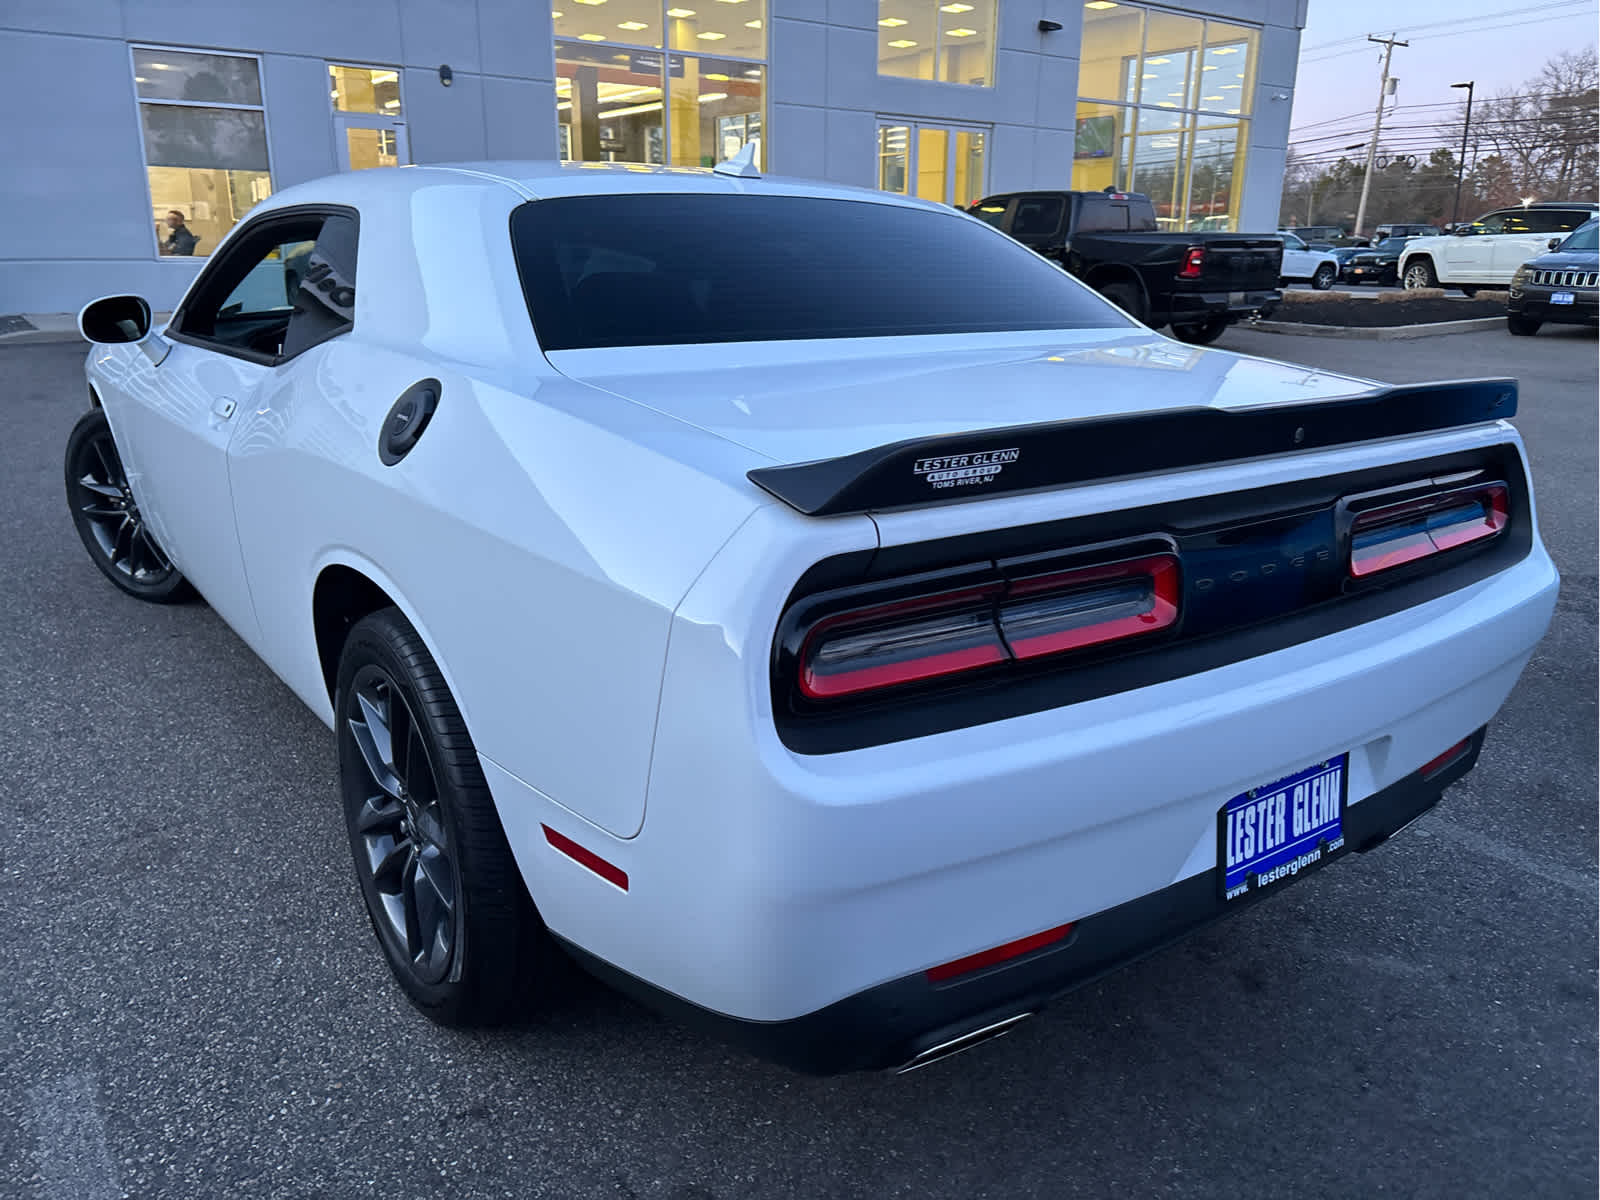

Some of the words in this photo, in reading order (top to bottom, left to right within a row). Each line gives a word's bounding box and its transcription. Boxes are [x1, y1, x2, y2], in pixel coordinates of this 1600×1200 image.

[914, 457, 969, 472] LESTER
[973, 450, 1020, 465] GLENN
[929, 472, 959, 481] AUTO
[932, 480, 955, 489] TOMS
[984, 475, 995, 483] NJ
[1195, 550, 1329, 590] DODGE
[1226, 792, 1287, 868] LESTER
[1292, 769, 1341, 838] GLENN
[1226, 884, 1249, 901] www.
[1258, 850, 1321, 887] lesterglenn
[1327, 838, 1345, 853] .com
